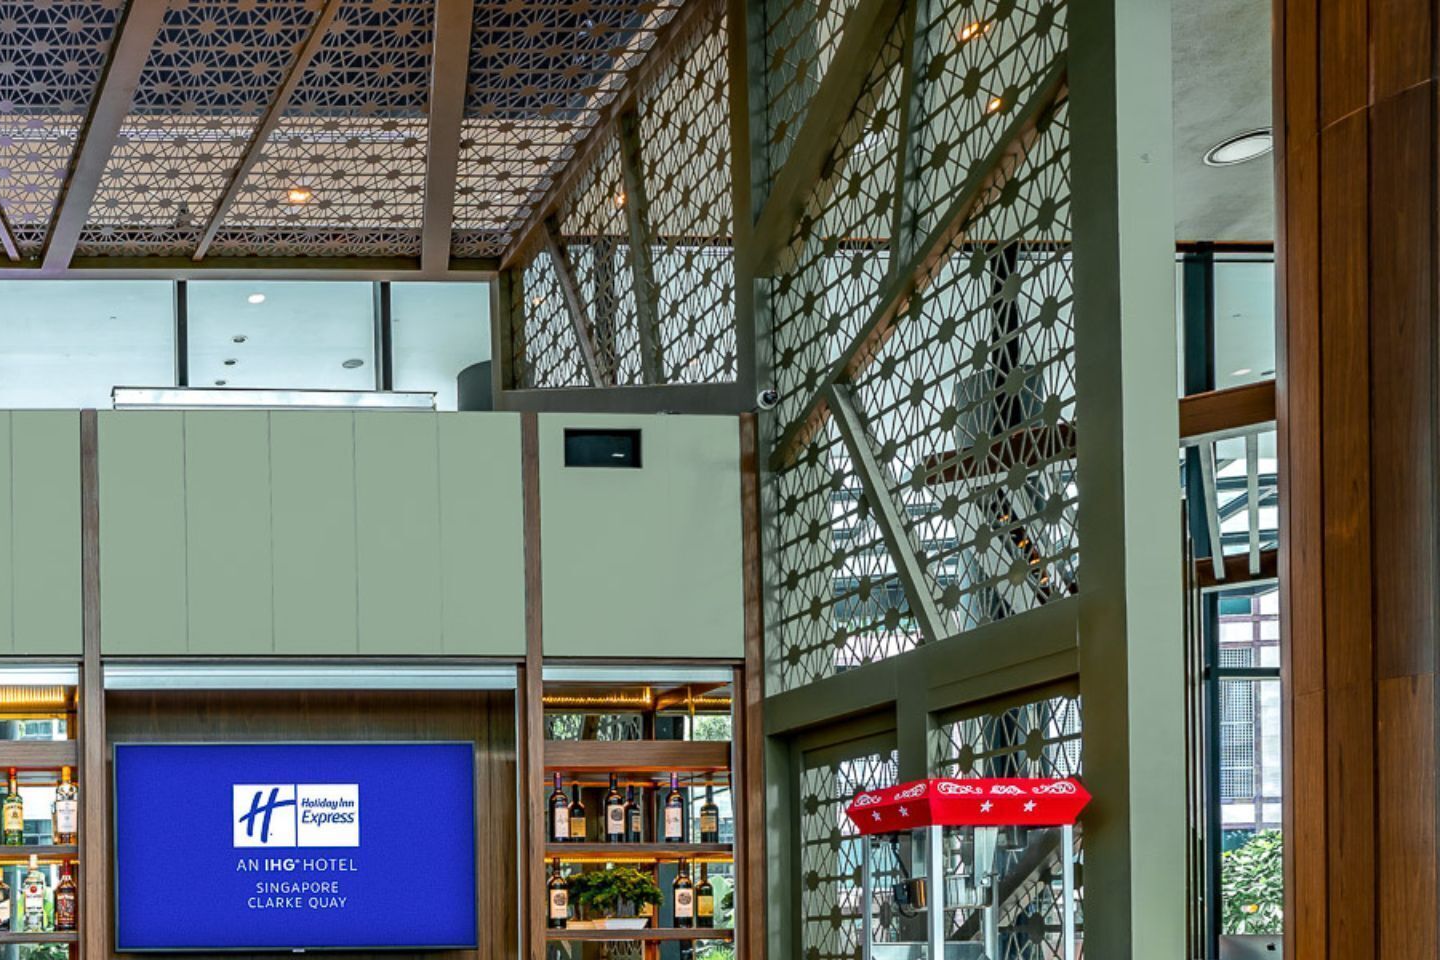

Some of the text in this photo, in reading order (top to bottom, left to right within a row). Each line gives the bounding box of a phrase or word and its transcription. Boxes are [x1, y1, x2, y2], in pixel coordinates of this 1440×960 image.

[301, 797, 355, 809] Holiday Inn
[301, 809, 355, 827] Express
[236, 859, 259, 872] AN
[303, 859, 358, 871] HOTEL
[256, 882, 339, 893] SINGAPORE
[247, 897, 347, 909] CLARKE QUAY
